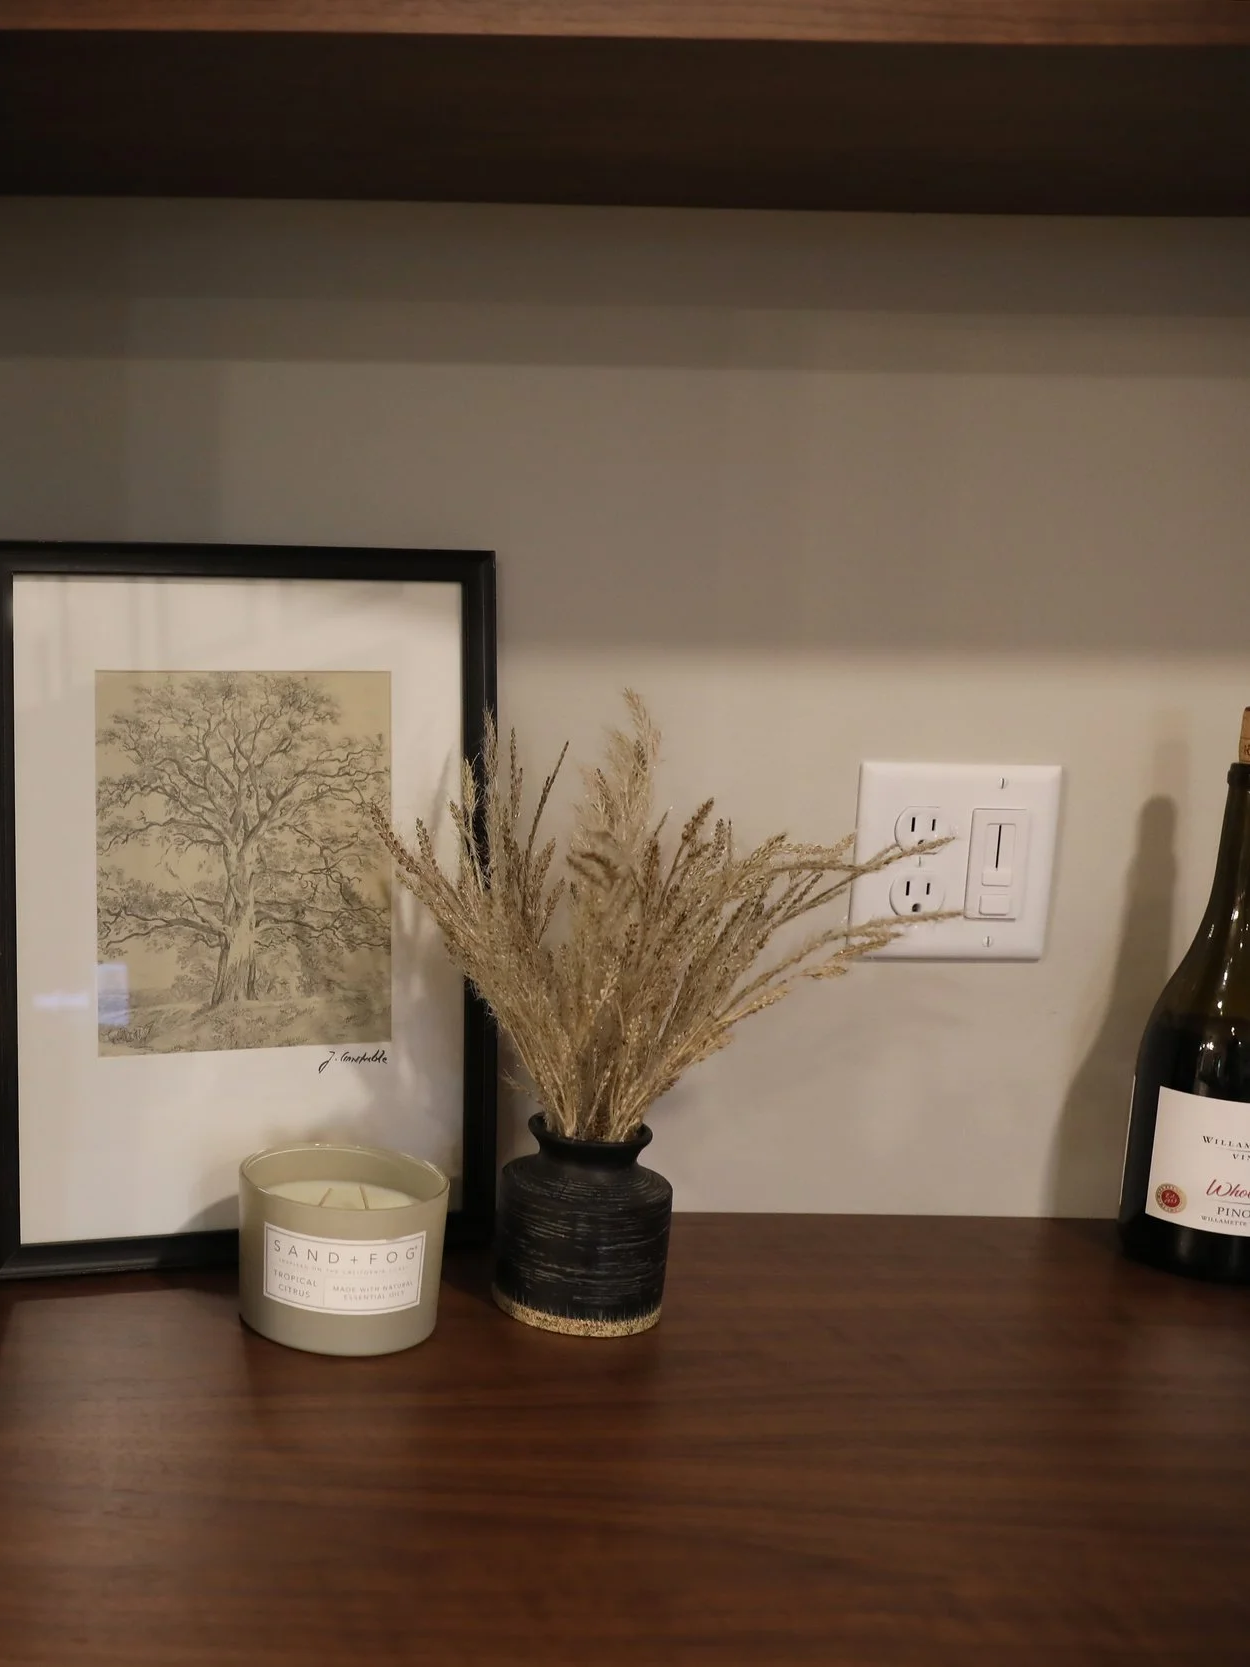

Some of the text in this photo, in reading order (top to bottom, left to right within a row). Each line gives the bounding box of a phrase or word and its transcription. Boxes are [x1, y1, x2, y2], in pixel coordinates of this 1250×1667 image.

[1232, 1153, 1250, 1161] VI
[273, 1268, 317, 1288] TROPICAL
[278, 1284, 311, 1299] CITRUS
[332, 1285, 356, 1293] MADE
[382, 1280, 414, 1292] NATURAL
[343, 1292, 386, 1301] ESSENTIAL
